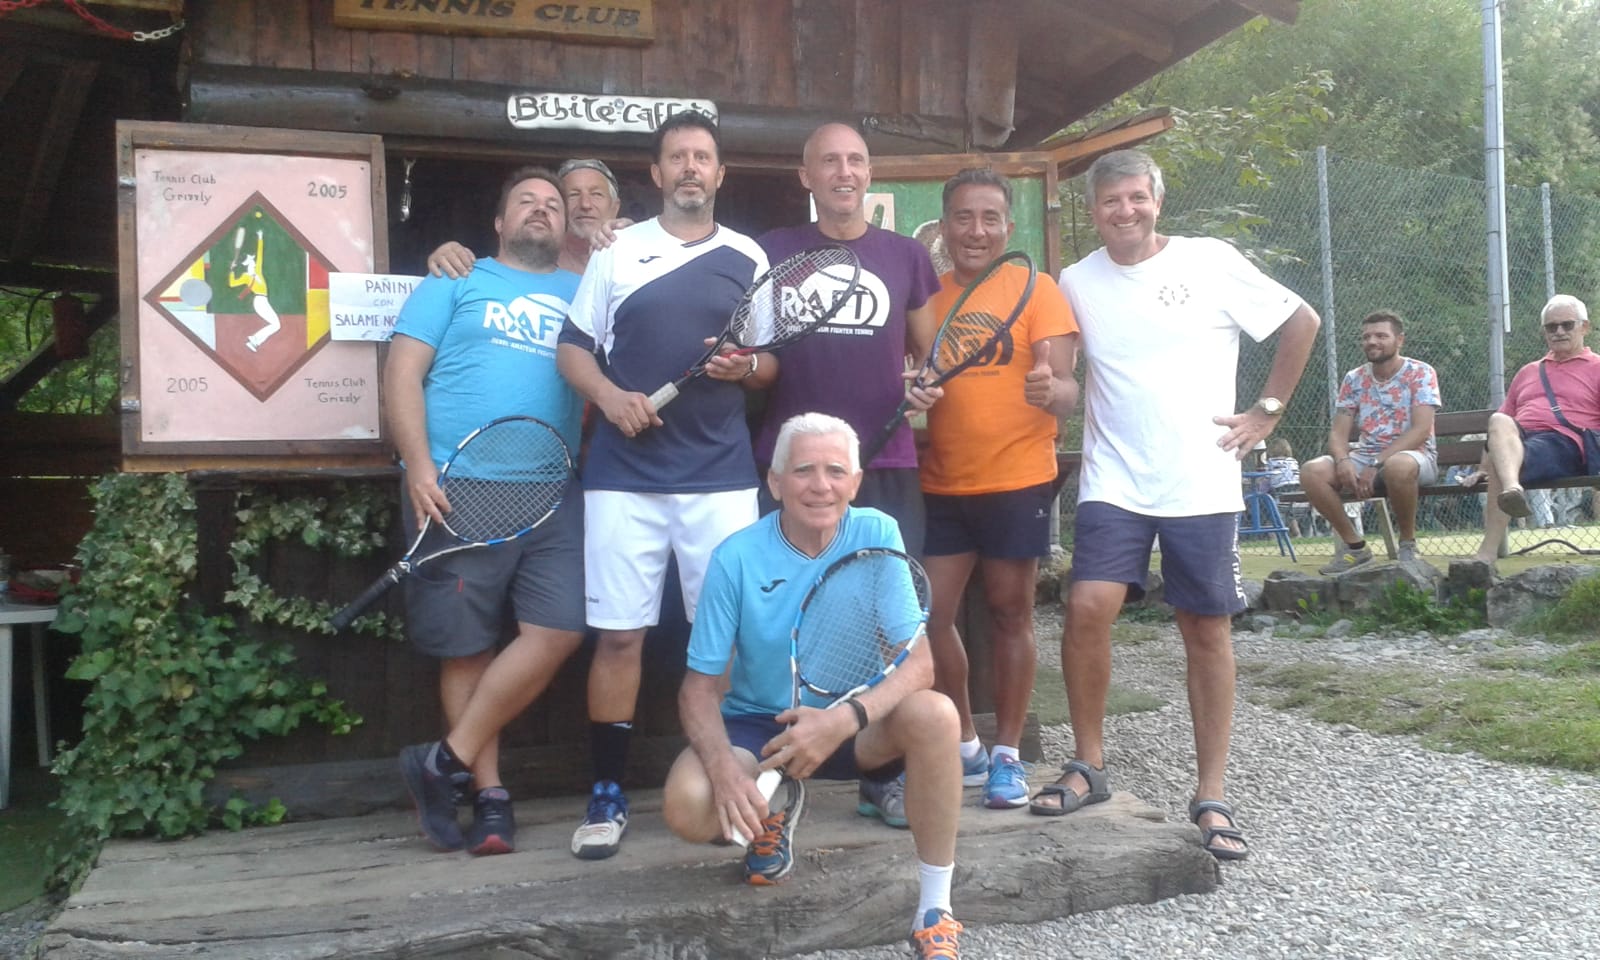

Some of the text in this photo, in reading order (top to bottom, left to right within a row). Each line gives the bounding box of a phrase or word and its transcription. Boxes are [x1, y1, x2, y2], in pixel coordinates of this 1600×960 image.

[534, 4, 641, 27] CLUB
[152, 170, 217, 184] Tennis Club
[307, 181, 347, 199] 2005
[373, 299, 395, 307] CON
[335, 313, 380, 327] SALAME
[483, 299, 564, 341] RAF
[167, 376, 208, 392] 2005
[304, 377, 366, 388] Tennis Club
